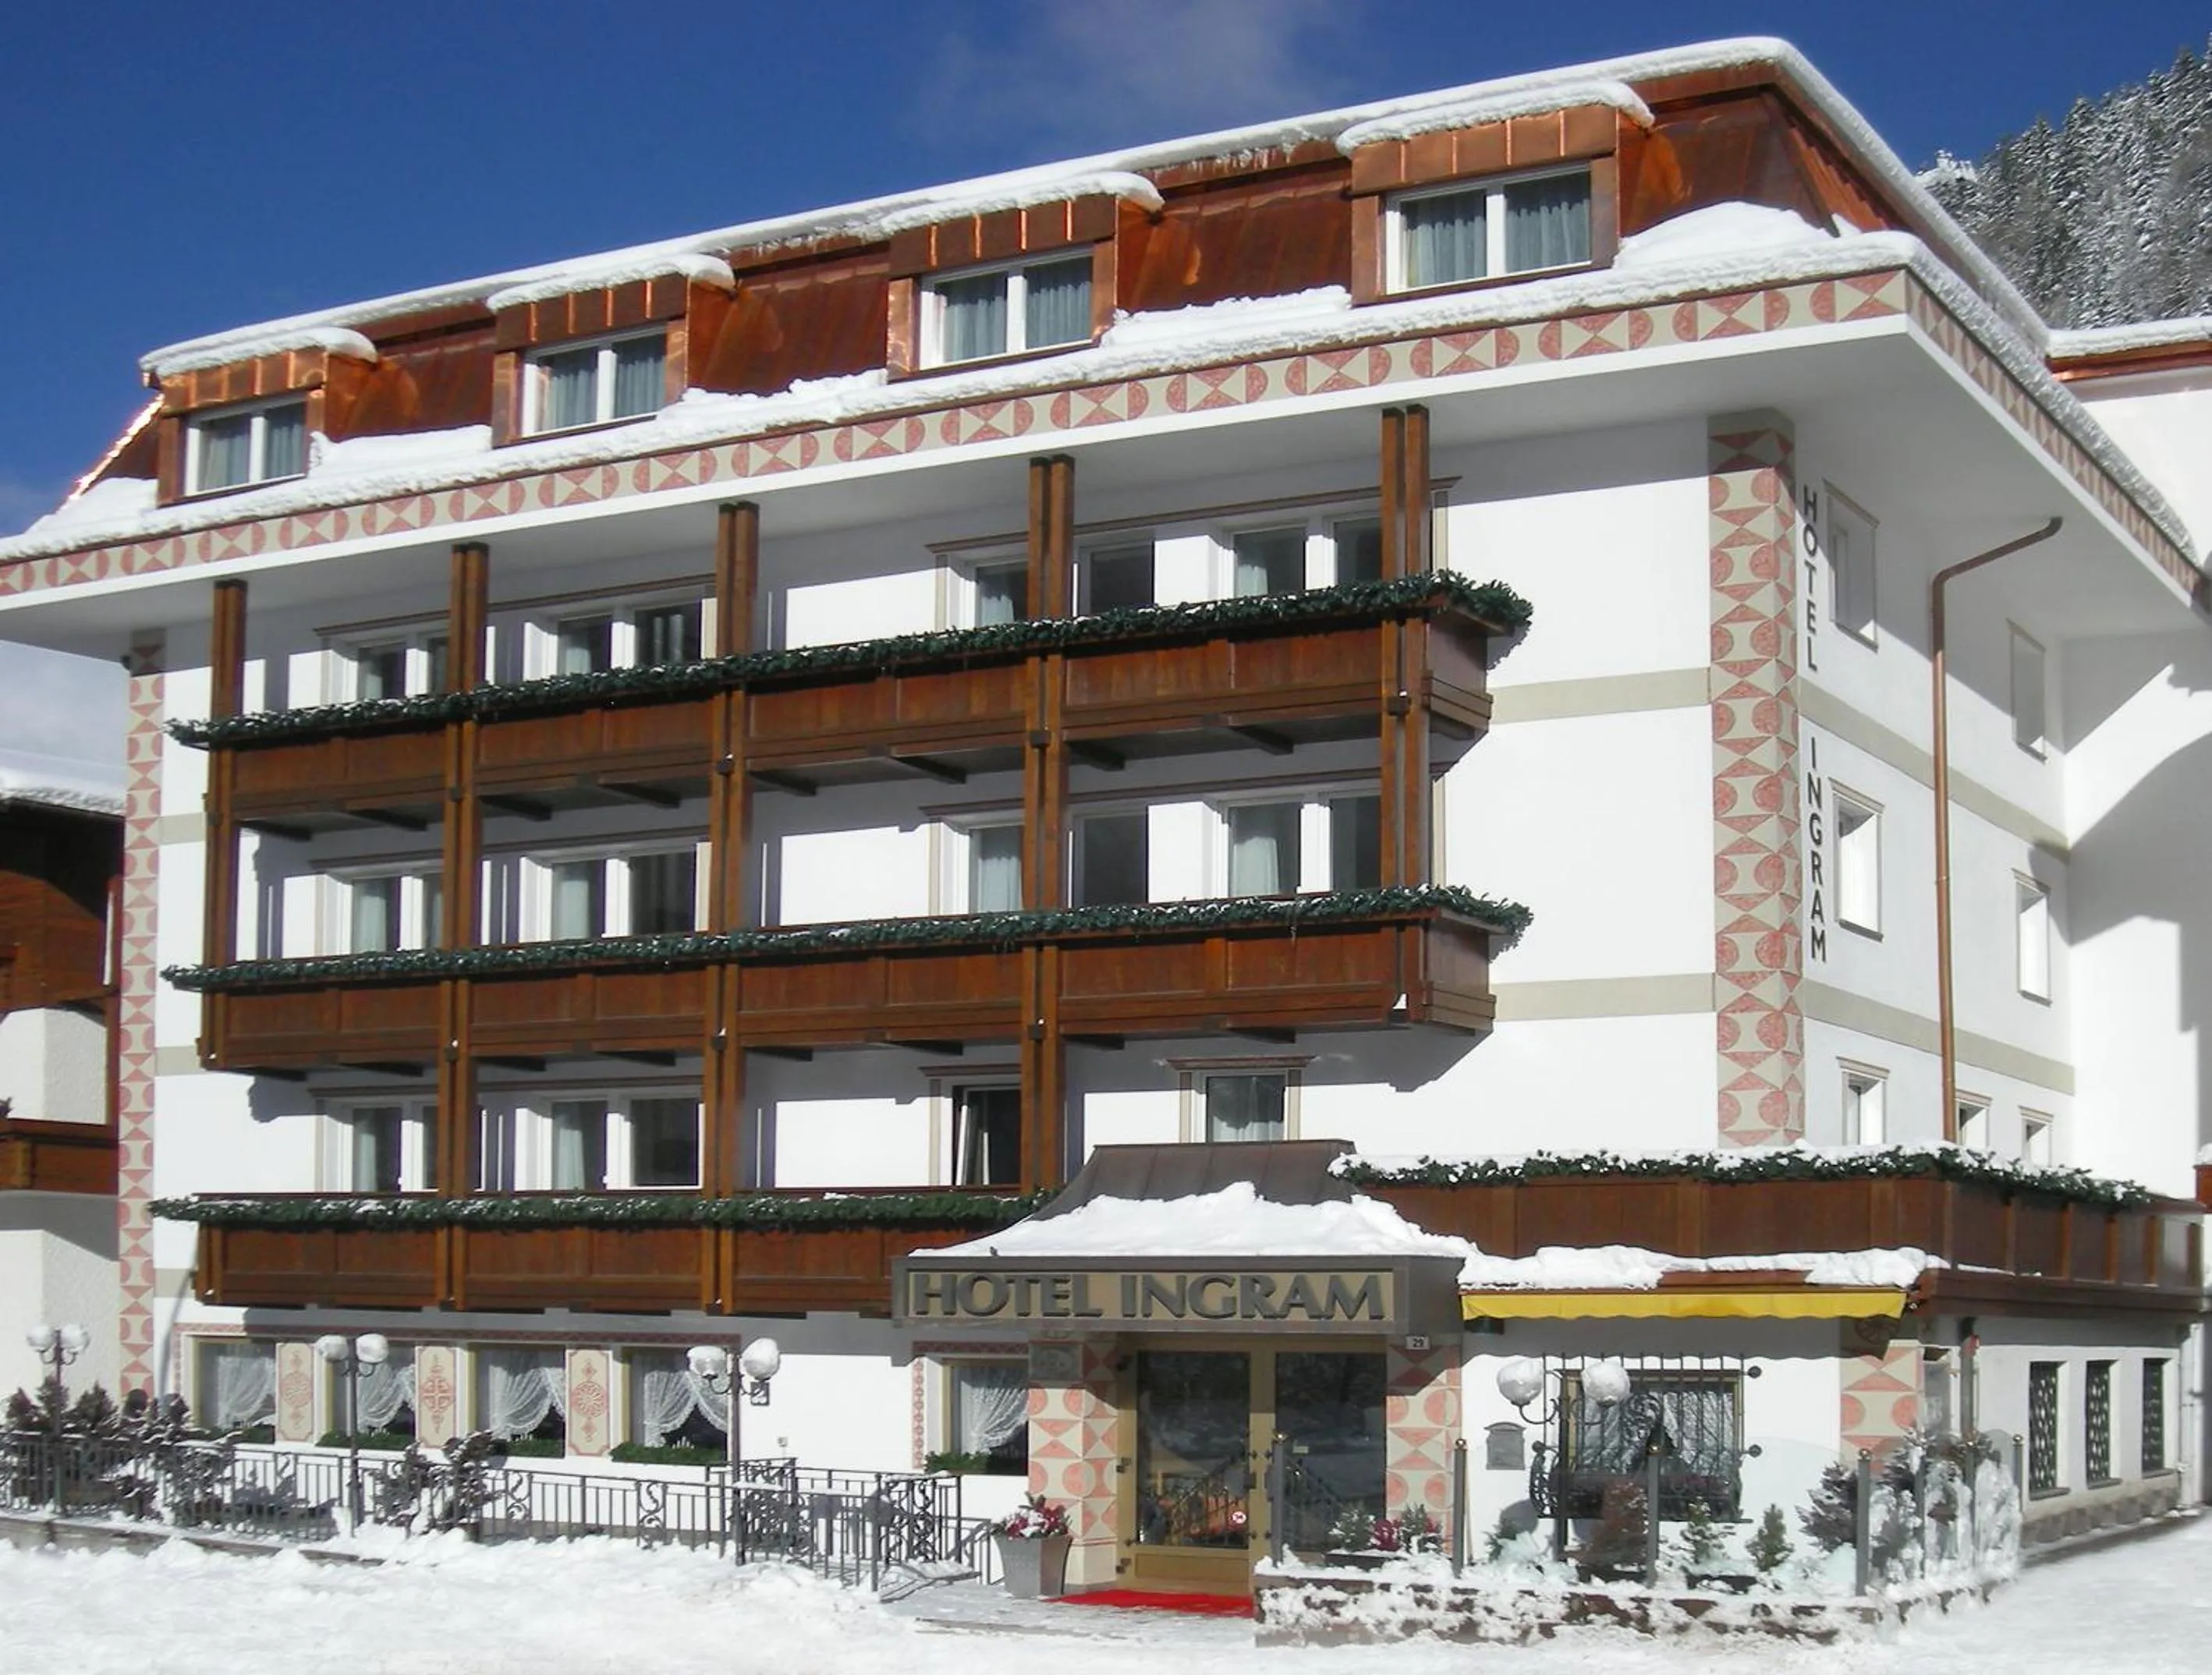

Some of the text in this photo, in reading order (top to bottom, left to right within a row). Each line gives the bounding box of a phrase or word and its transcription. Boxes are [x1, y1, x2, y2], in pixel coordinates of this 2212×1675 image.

[1803, 483, 1827, 963] HOTEL INGRAM
[913, 1273, 1385, 1319] HOTEL INGRAM
